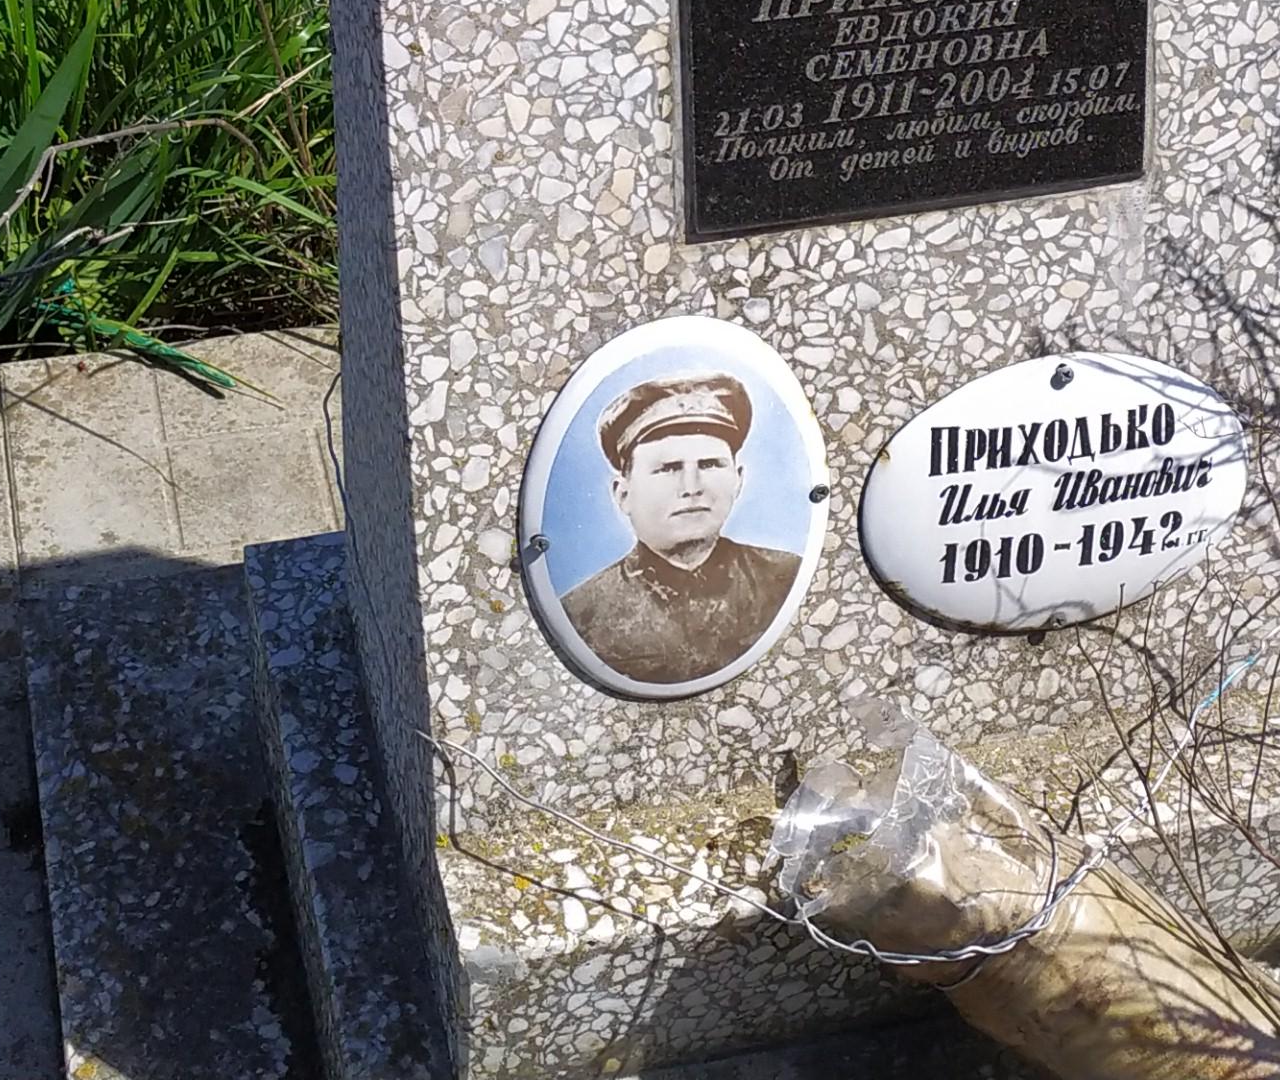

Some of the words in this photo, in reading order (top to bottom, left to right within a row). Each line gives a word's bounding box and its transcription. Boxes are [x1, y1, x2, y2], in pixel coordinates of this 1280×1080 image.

[805, 29, 1050, 82] СЕМЕНОВНА
[714, 102, 804, 137] 21.03
[1046, 63, 1130, 96] 15.07
[715, 129, 865, 163] Помним,
[887, 111, 1002, 140] любим,
[770, 156, 814, 182] От
[840, 146, 936, 181] детей
[954, 141, 974, 159] и
[929, 403, 1175, 477] ПРИХОДЬКО
[938, 484, 1031, 526] Илья
[1052, 456, 1213, 512] Иванович
